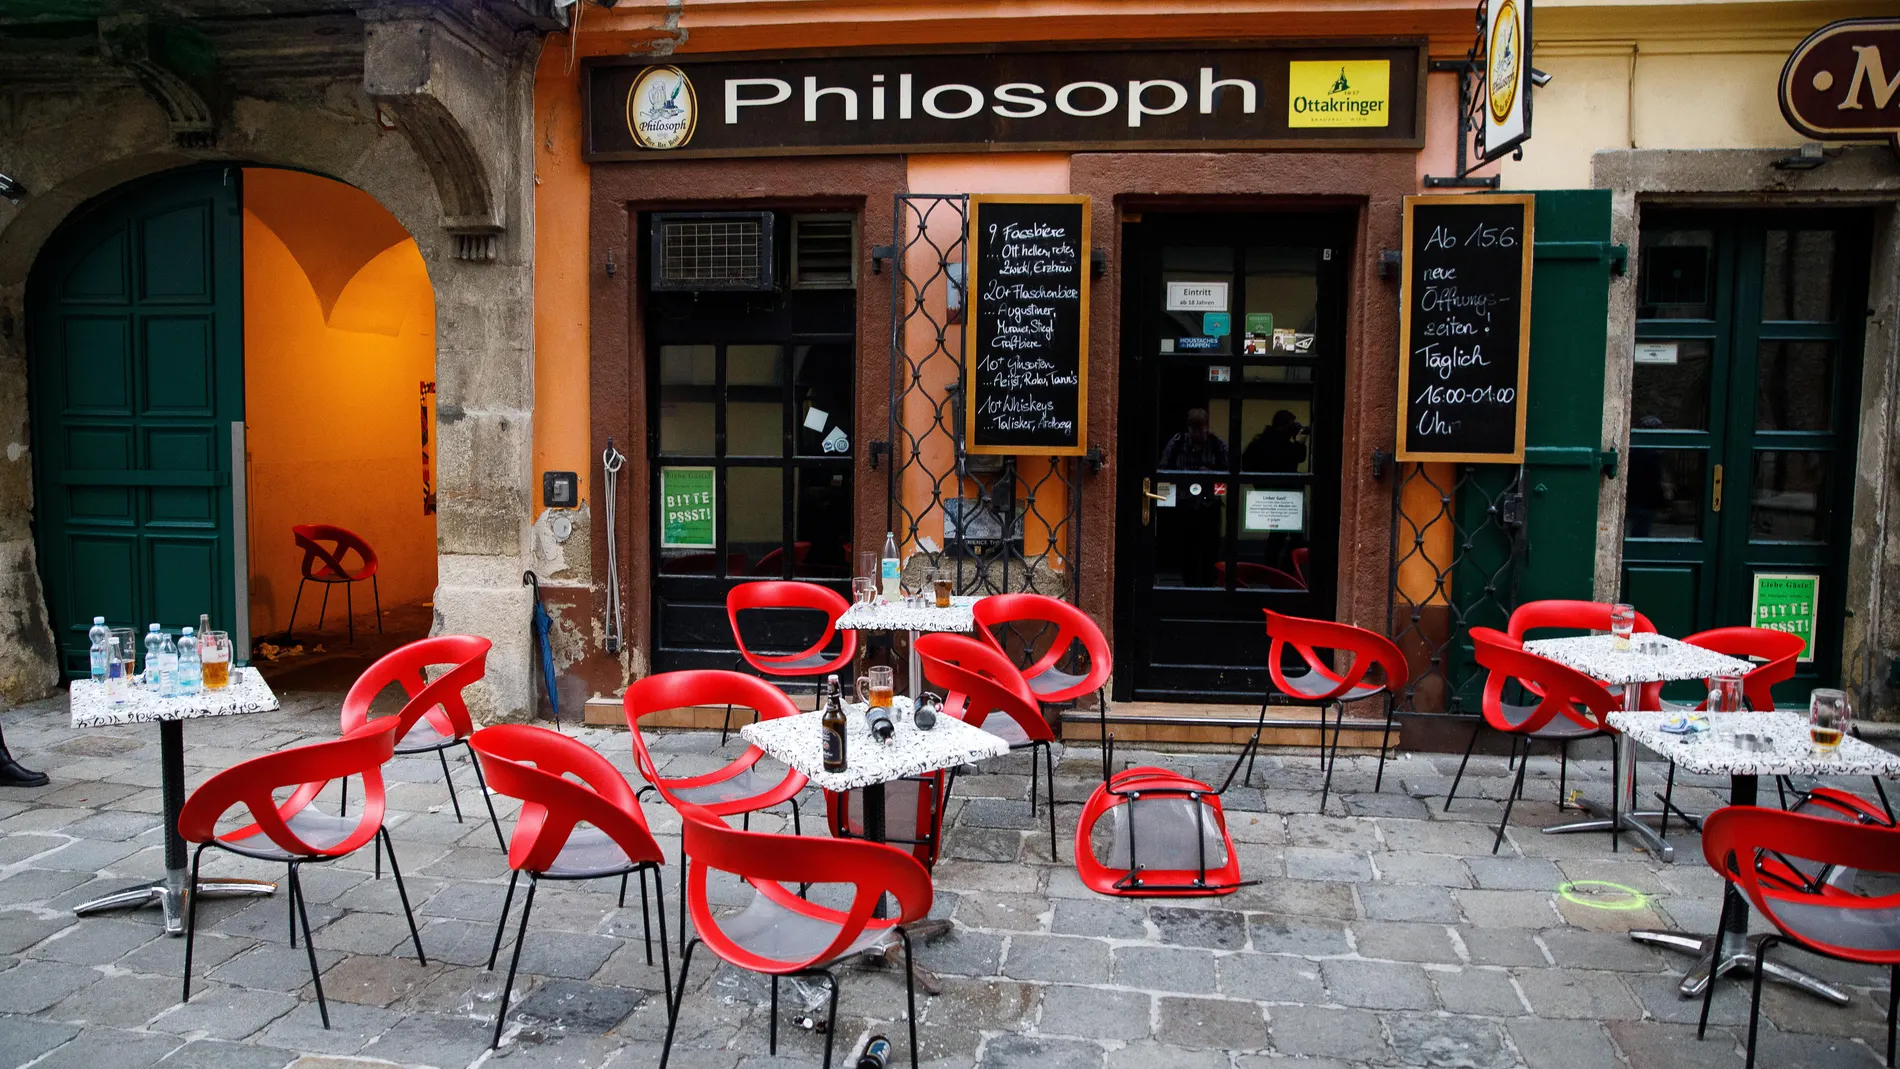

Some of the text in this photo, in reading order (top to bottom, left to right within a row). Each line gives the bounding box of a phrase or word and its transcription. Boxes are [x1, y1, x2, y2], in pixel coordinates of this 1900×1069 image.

[724, 68, 1257, 128] Philosoph
[1293, 96, 1385, 116] Ottakringer
[639, 119, 687, 133] Philosoph
[989, 222, 1066, 244] 9 Fassbiere
[1424, 222, 1518, 251] Ab 15.6.
[1423, 266, 1457, 281] neue
[1183, 288, 1212, 296] Eintritt
[991, 335, 1043, 351] Craftbiere
[1415, 342, 1491, 379] Täglich
[1415, 384, 1515, 404] 16:00-01:00
[1002, 393, 1055, 418] Whiskeys
[667, 491, 710, 508] BITTE
[669, 508, 711, 524] PSSST!
[1760, 602, 1809, 619] BITTE
